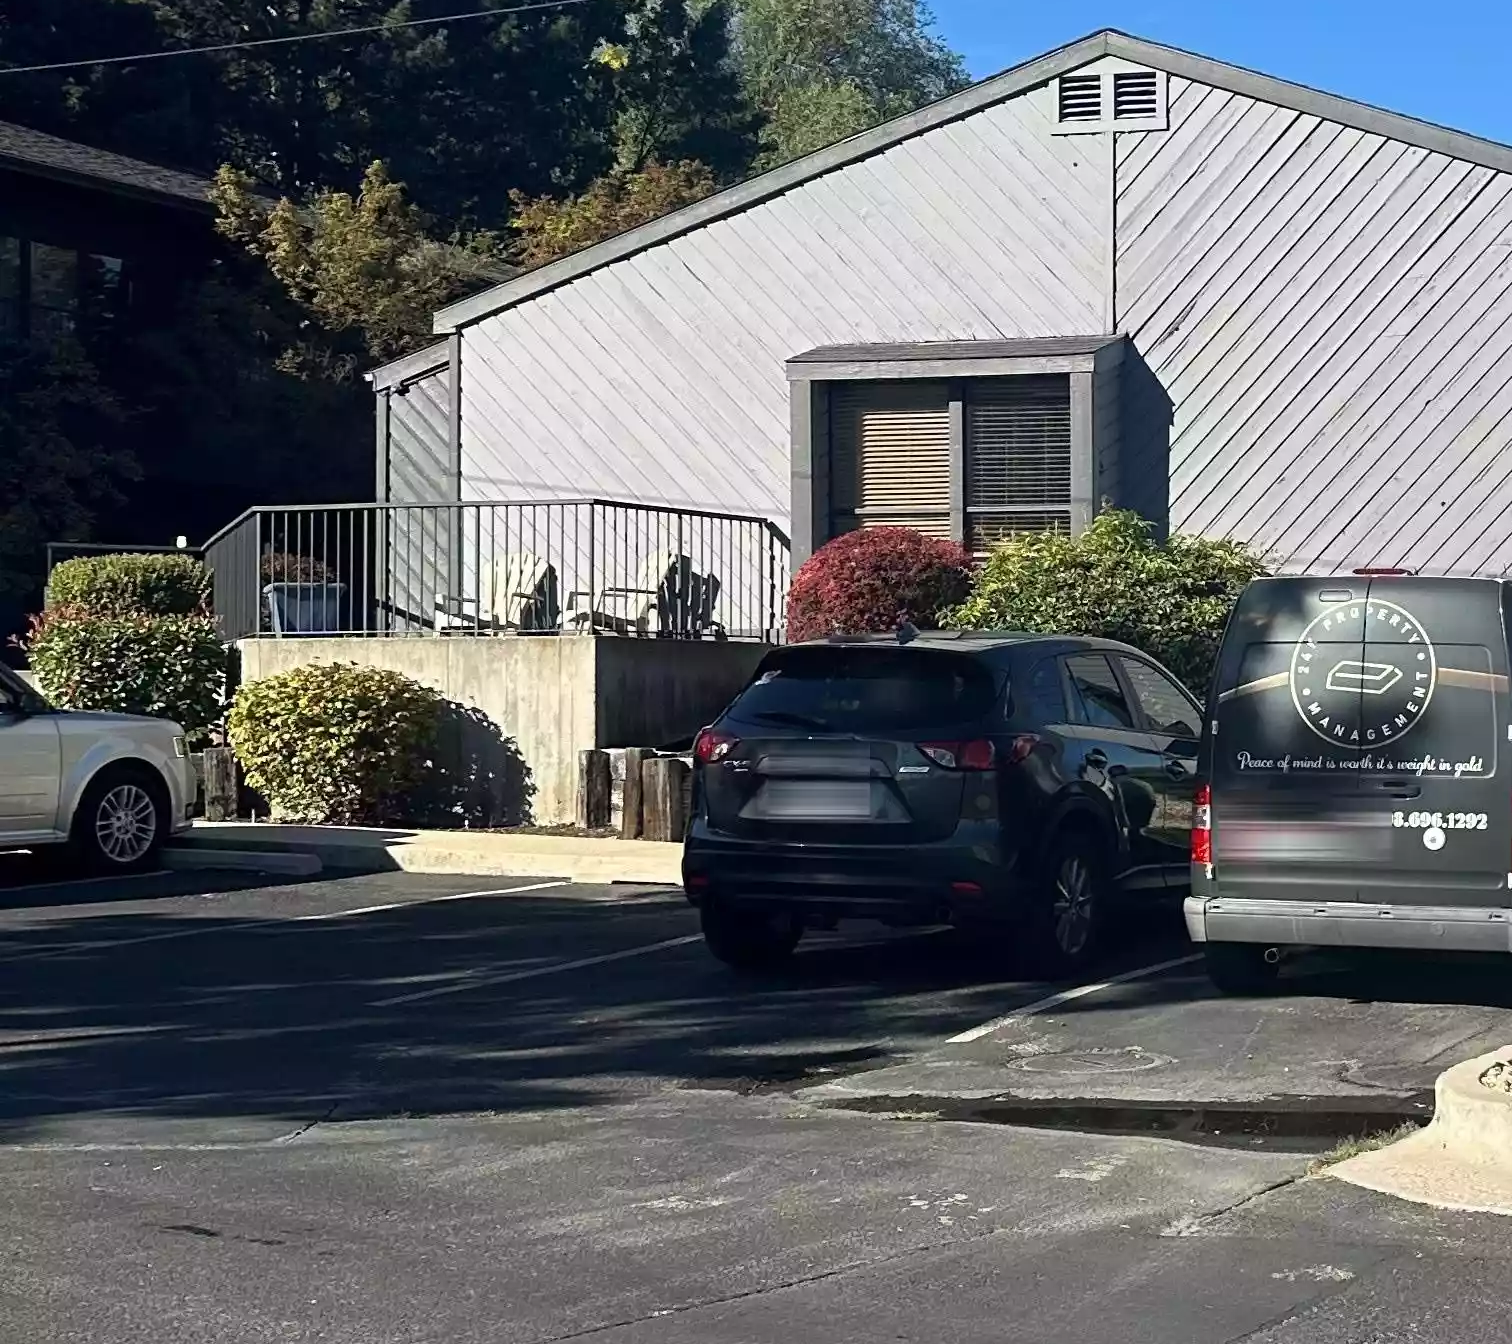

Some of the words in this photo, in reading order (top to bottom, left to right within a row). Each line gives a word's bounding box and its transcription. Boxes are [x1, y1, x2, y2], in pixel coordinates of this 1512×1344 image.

[1322, 606, 1421, 644] PROPERTY
[1308, 671, 1428, 741] MANAGEMENT
[1237, 751, 1274, 770] Peace
[1277, 755, 1290, 774] of
[1292, 755, 1323, 769] mind
[1326, 757, 1337, 769] is
[1339, 754, 1373, 770] worth
[1397, 755, 1436, 776] weight
[1438, 756, 1451, 771] in
[1454, 756, 1483, 777] gold
[1392, 811, 1488, 830] 8.696.1292
